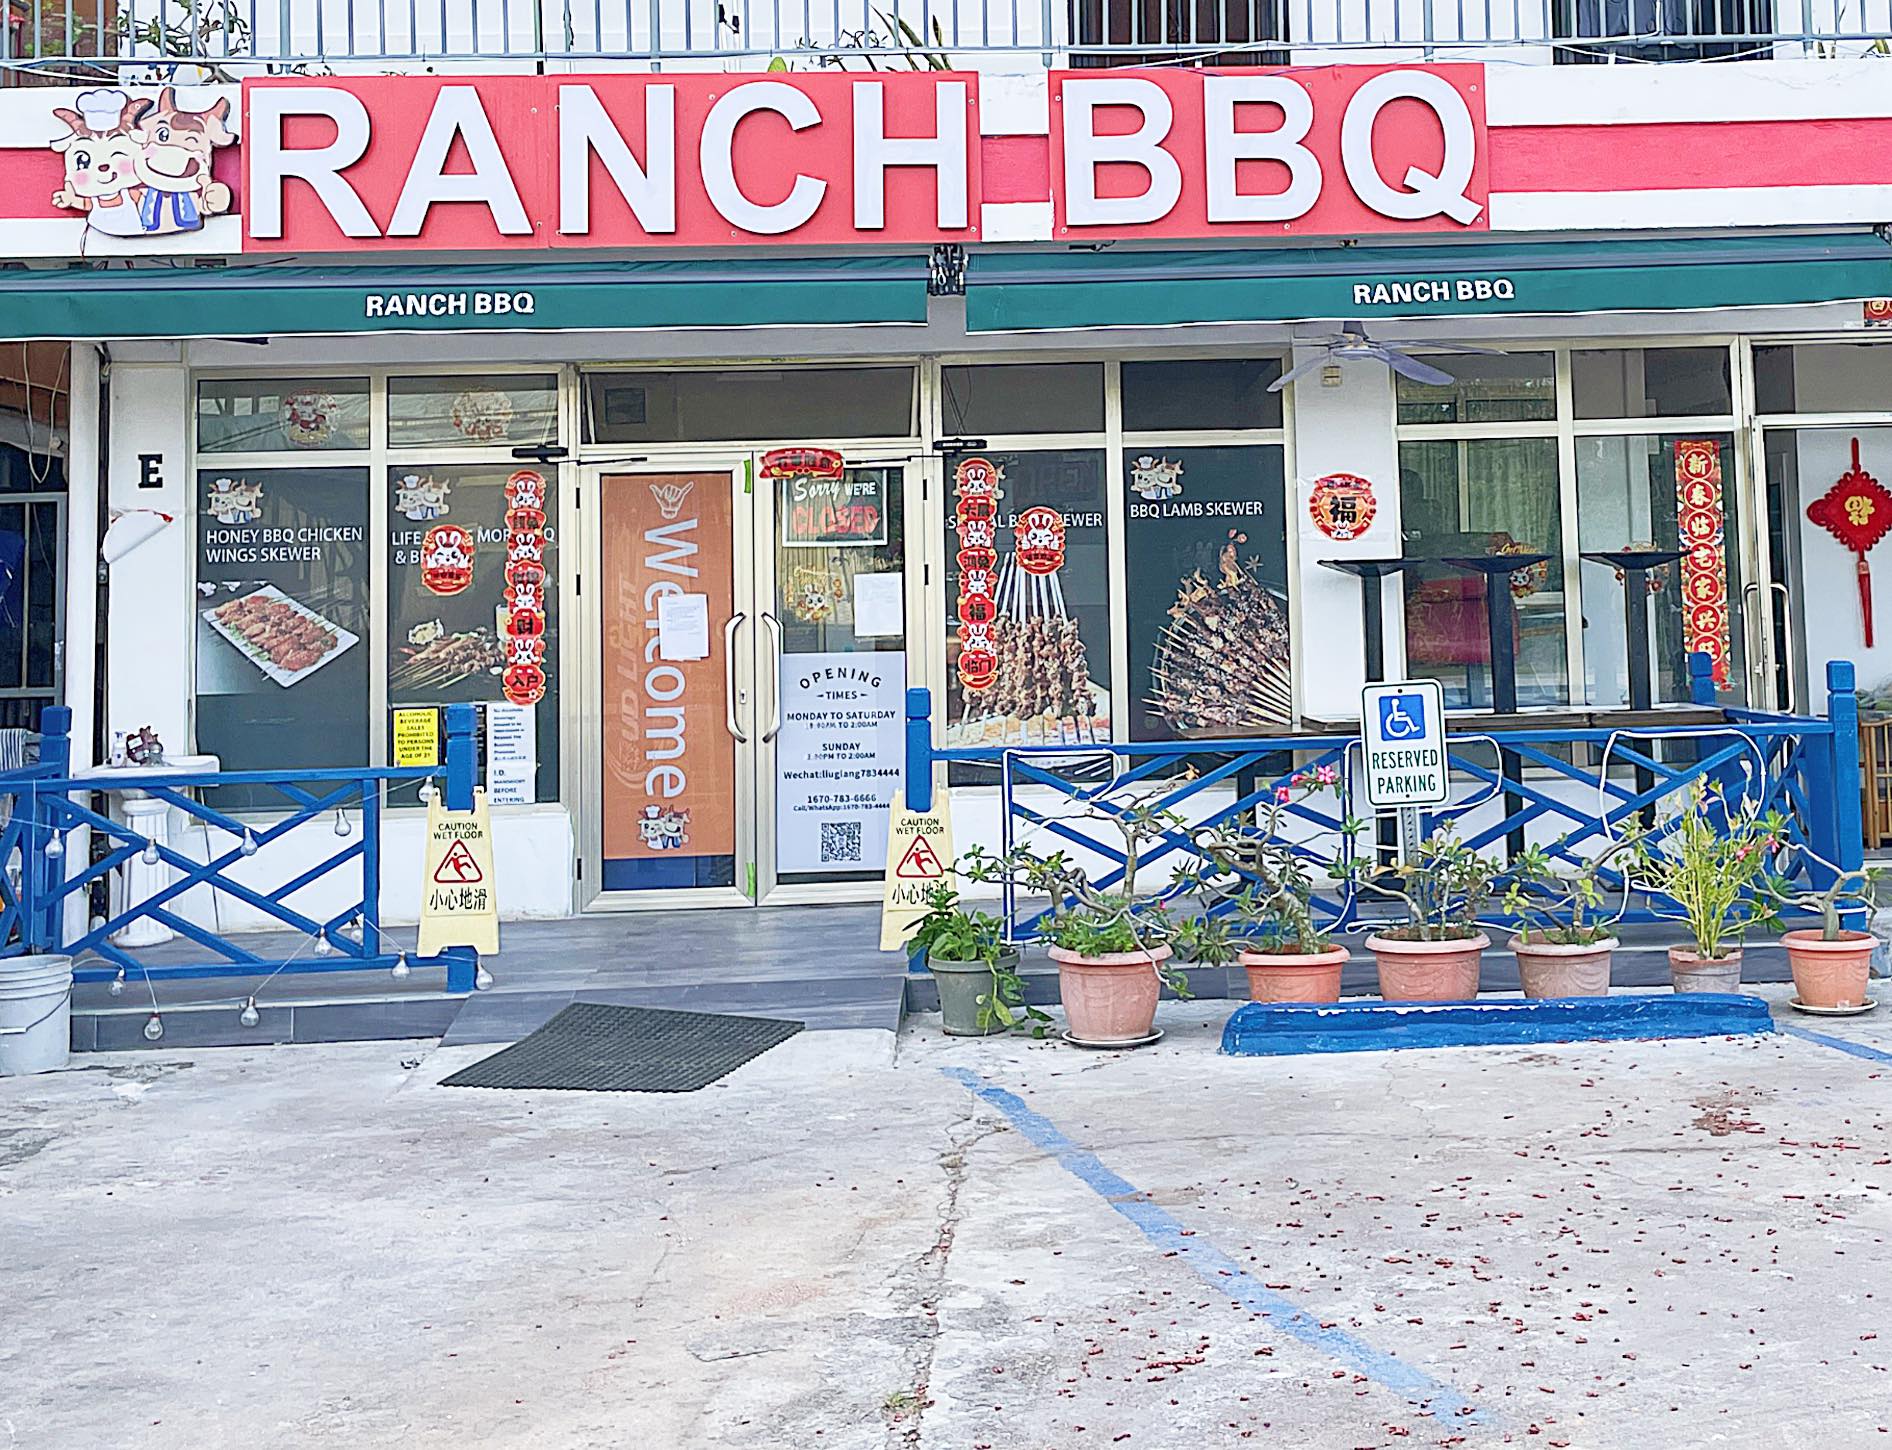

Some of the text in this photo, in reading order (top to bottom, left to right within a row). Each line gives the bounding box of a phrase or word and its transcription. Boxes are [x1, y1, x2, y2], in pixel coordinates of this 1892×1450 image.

[249, 69, 1484, 238] RANCH BBQ
[1353, 279, 1515, 304] RANCH BBQ
[366, 292, 535, 317] RANCH BBQ
[138, 453, 163, 488] E
[794, 477, 876, 501] Sorry WE'RE
[1130, 501, 1262, 518] BBQ LAMB SKEWER
[1330, 496, 1357, 524] 福
[793, 505, 880, 535] CLOSED
[206, 527, 363, 544] HONEY BBQ CHICKEN
[206, 547, 321, 563] WINGS SKEWER
[395, 550, 406, 564] &
[799, 667, 882, 690] OPENING
[826, 691, 858, 700] TIMES
[786, 711, 896, 720] MONDAY TO SATURDAY
[822, 743, 861, 751] SUNDAY
[1372, 749, 1438, 770] RESERVED
[1377, 774, 1436, 794] PARKING
[438, 822, 478, 831] CAUTION
[896, 826, 944, 835] WET FLOOR
[900, 818, 940, 827] CAUTION
[433, 830, 483, 840] WET FLOOR
[430, 886, 488, 911] 小心地滑
